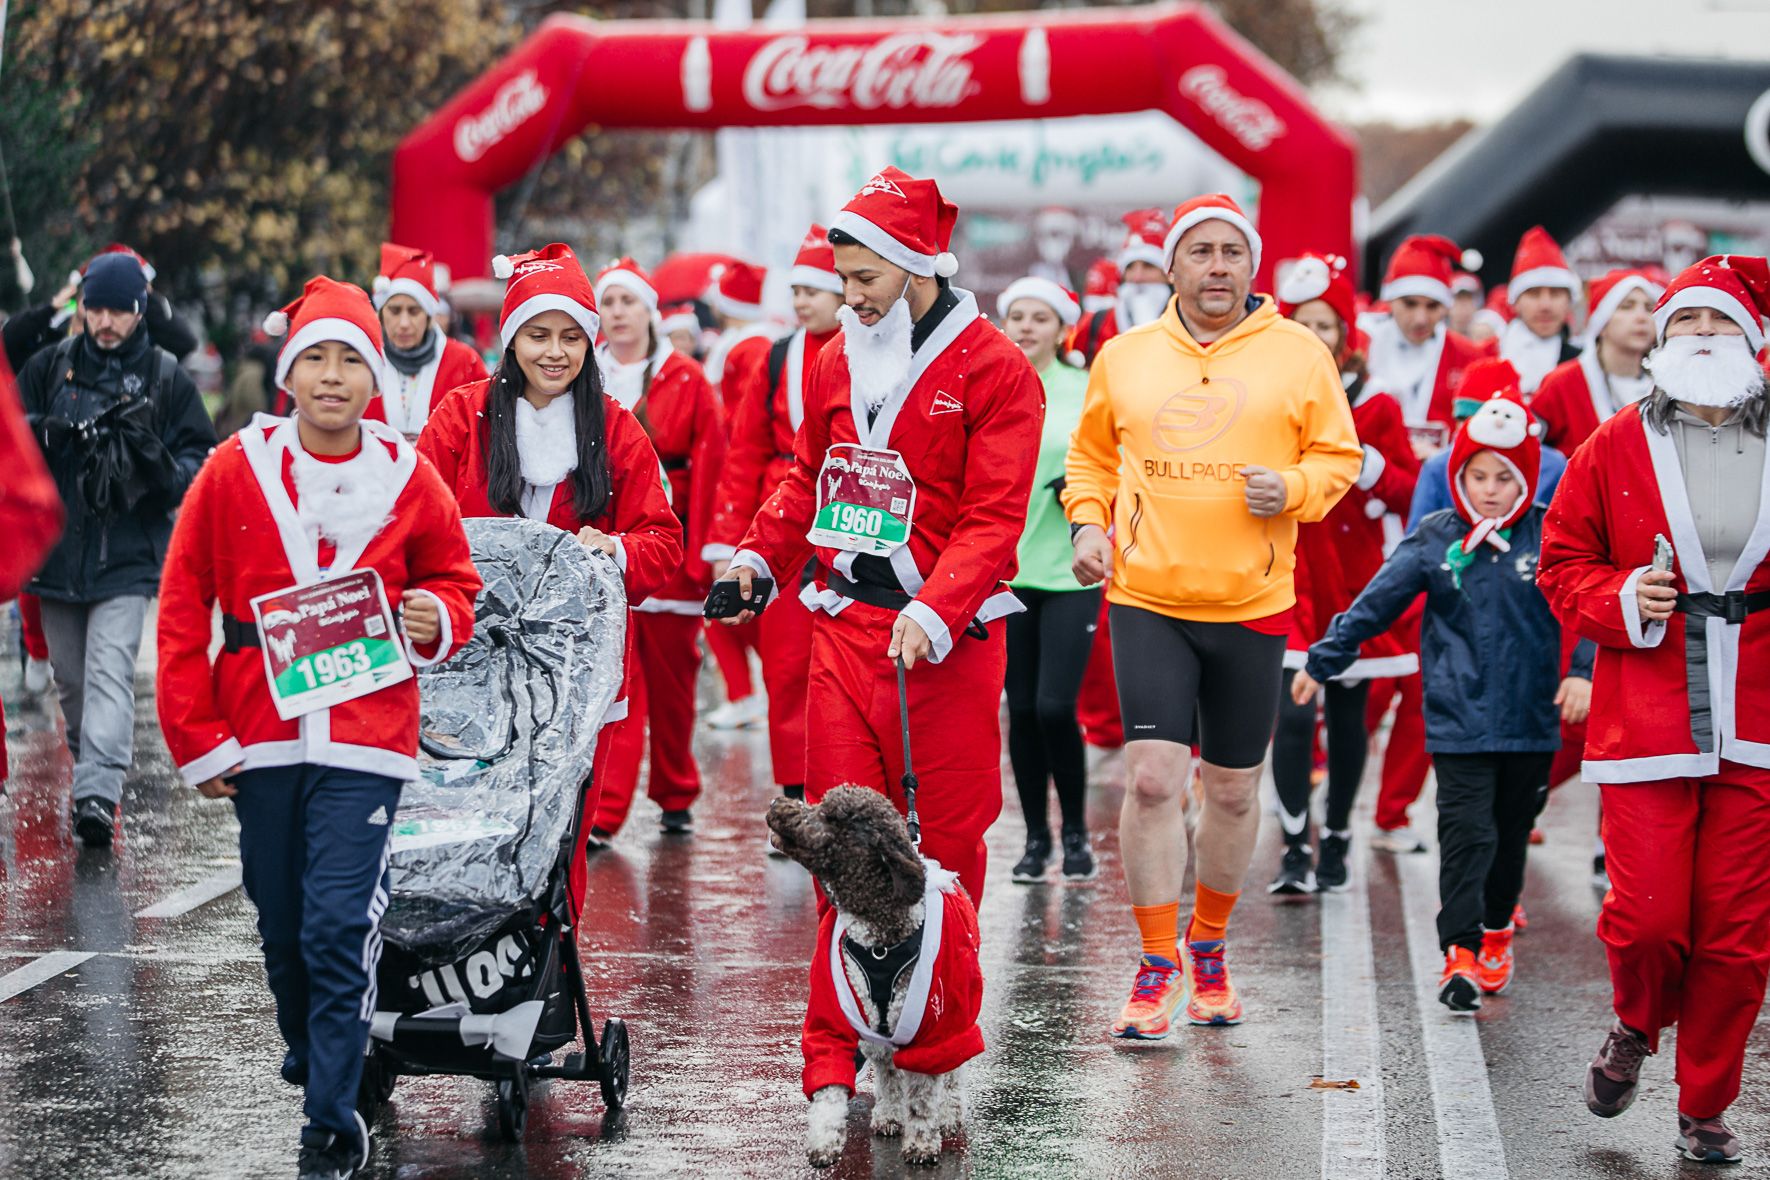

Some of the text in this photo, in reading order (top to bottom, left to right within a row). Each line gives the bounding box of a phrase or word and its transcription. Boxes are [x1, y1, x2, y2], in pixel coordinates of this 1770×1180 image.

[850, 461, 877, 478] Papá
[1144, 459, 1247, 482] BULLPADE
[831, 504, 883, 536] 1960
[335, 585, 371, 608] Noel
[296, 642, 372, 689] 1963
[419, 815, 484, 834] 196
